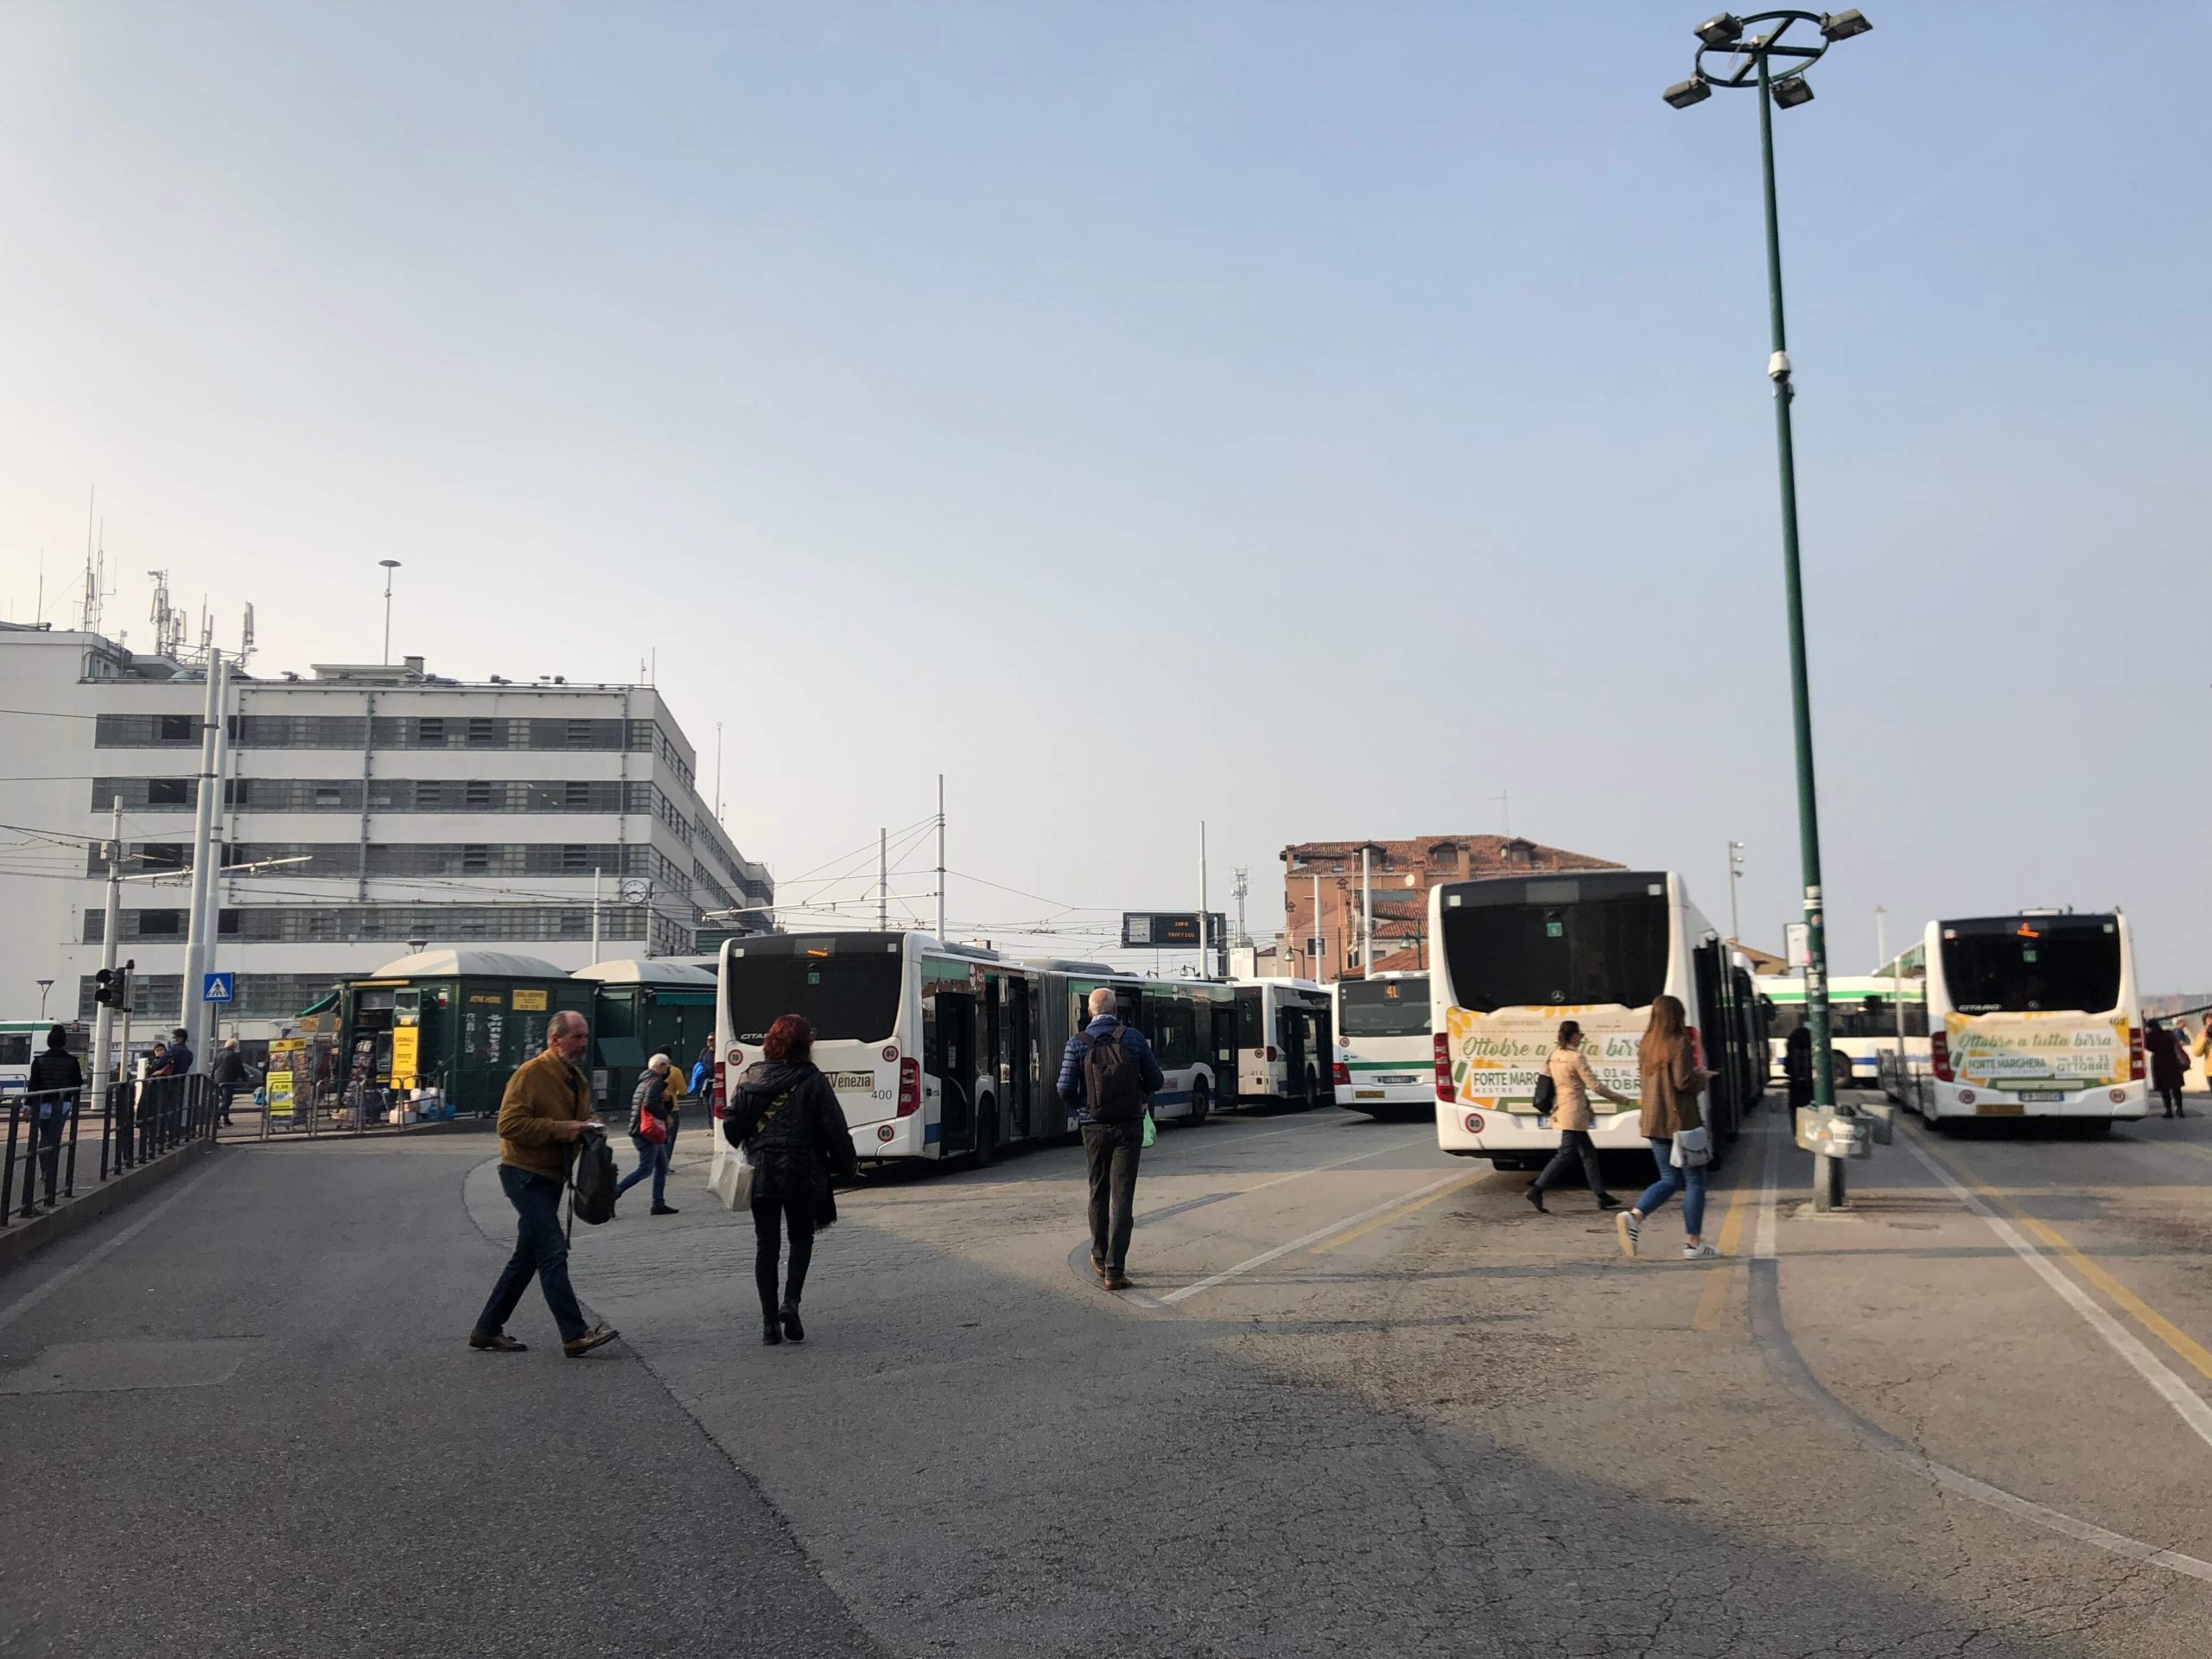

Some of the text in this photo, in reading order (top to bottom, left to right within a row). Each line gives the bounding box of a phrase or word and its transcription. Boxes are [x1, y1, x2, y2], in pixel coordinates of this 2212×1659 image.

[1386, 985, 1399, 998] 4L
[1463, 1036, 1548, 1057] Ottobre a
[1958, 1033, 2112, 1048] Ottobre a tutta birra
[1967, 1058, 2045, 1069] FORTE MARGHERA
[2056, 1062, 2110, 1071] OTTOBRE
[1474, 1072, 1508, 1085] FORTE
[1603, 1068, 1618, 1077] 01
[830, 1073, 871, 1088] Venezia
[871, 1090, 893, 1100] 400
[881, 1129, 890, 1138] 80
